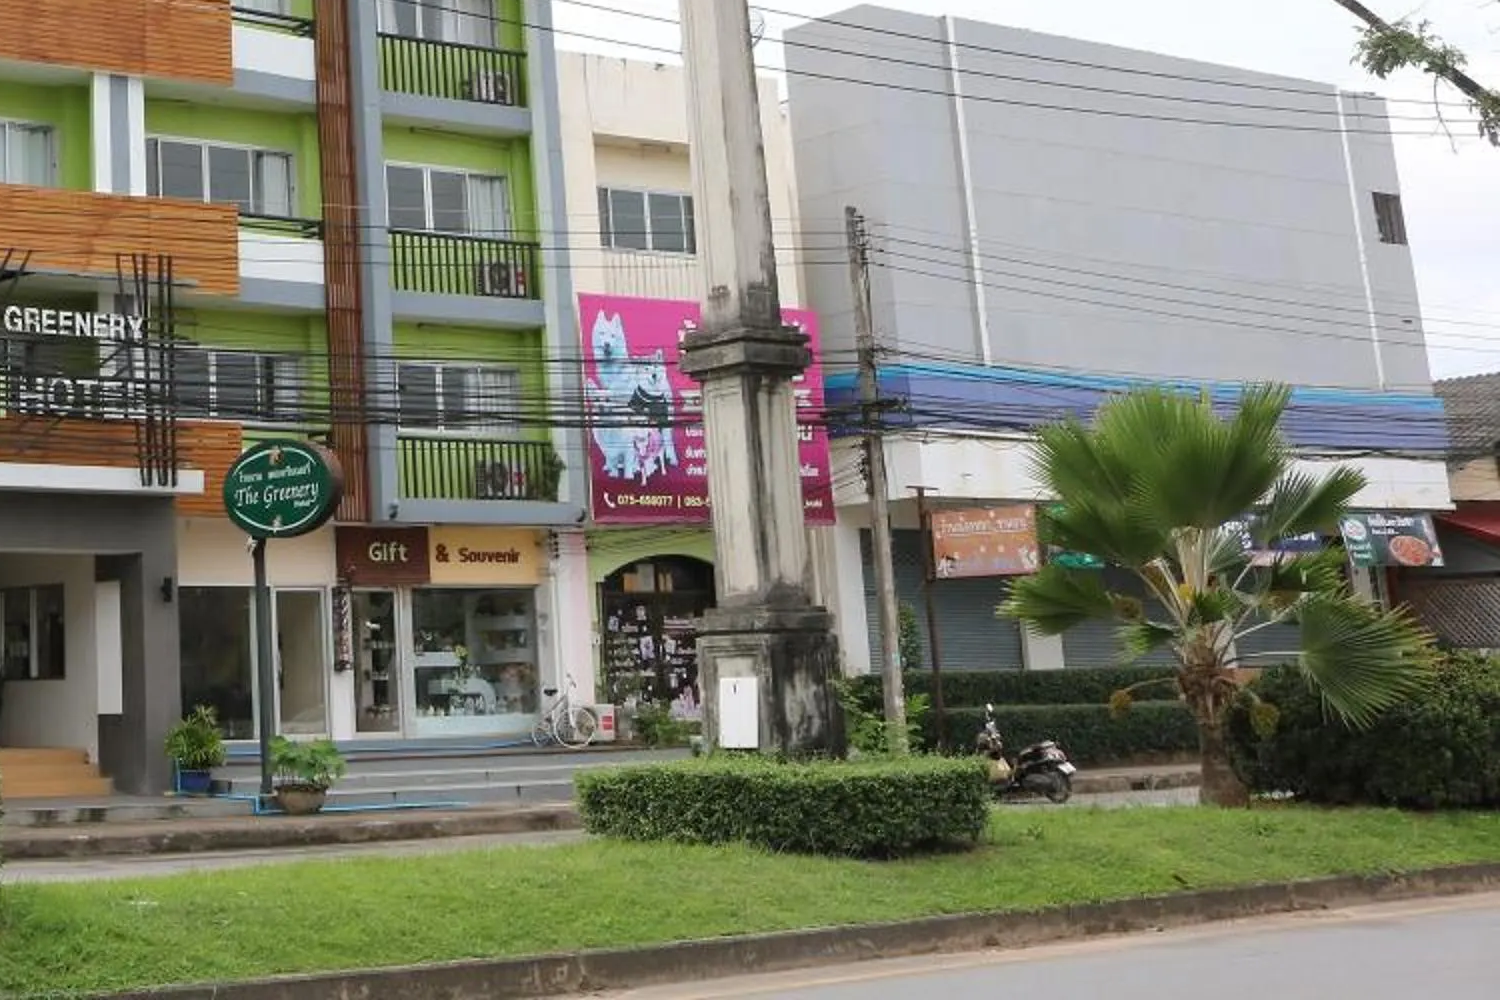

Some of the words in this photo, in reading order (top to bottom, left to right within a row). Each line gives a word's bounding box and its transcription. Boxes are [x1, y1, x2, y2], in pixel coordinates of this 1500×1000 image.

[4, 305, 144, 341] GREENERY
[234, 484, 260, 508] The
[263, 482, 320, 509] Greenery
[435, 544, 450, 564] &
[458, 548, 521, 565] Souvenir
